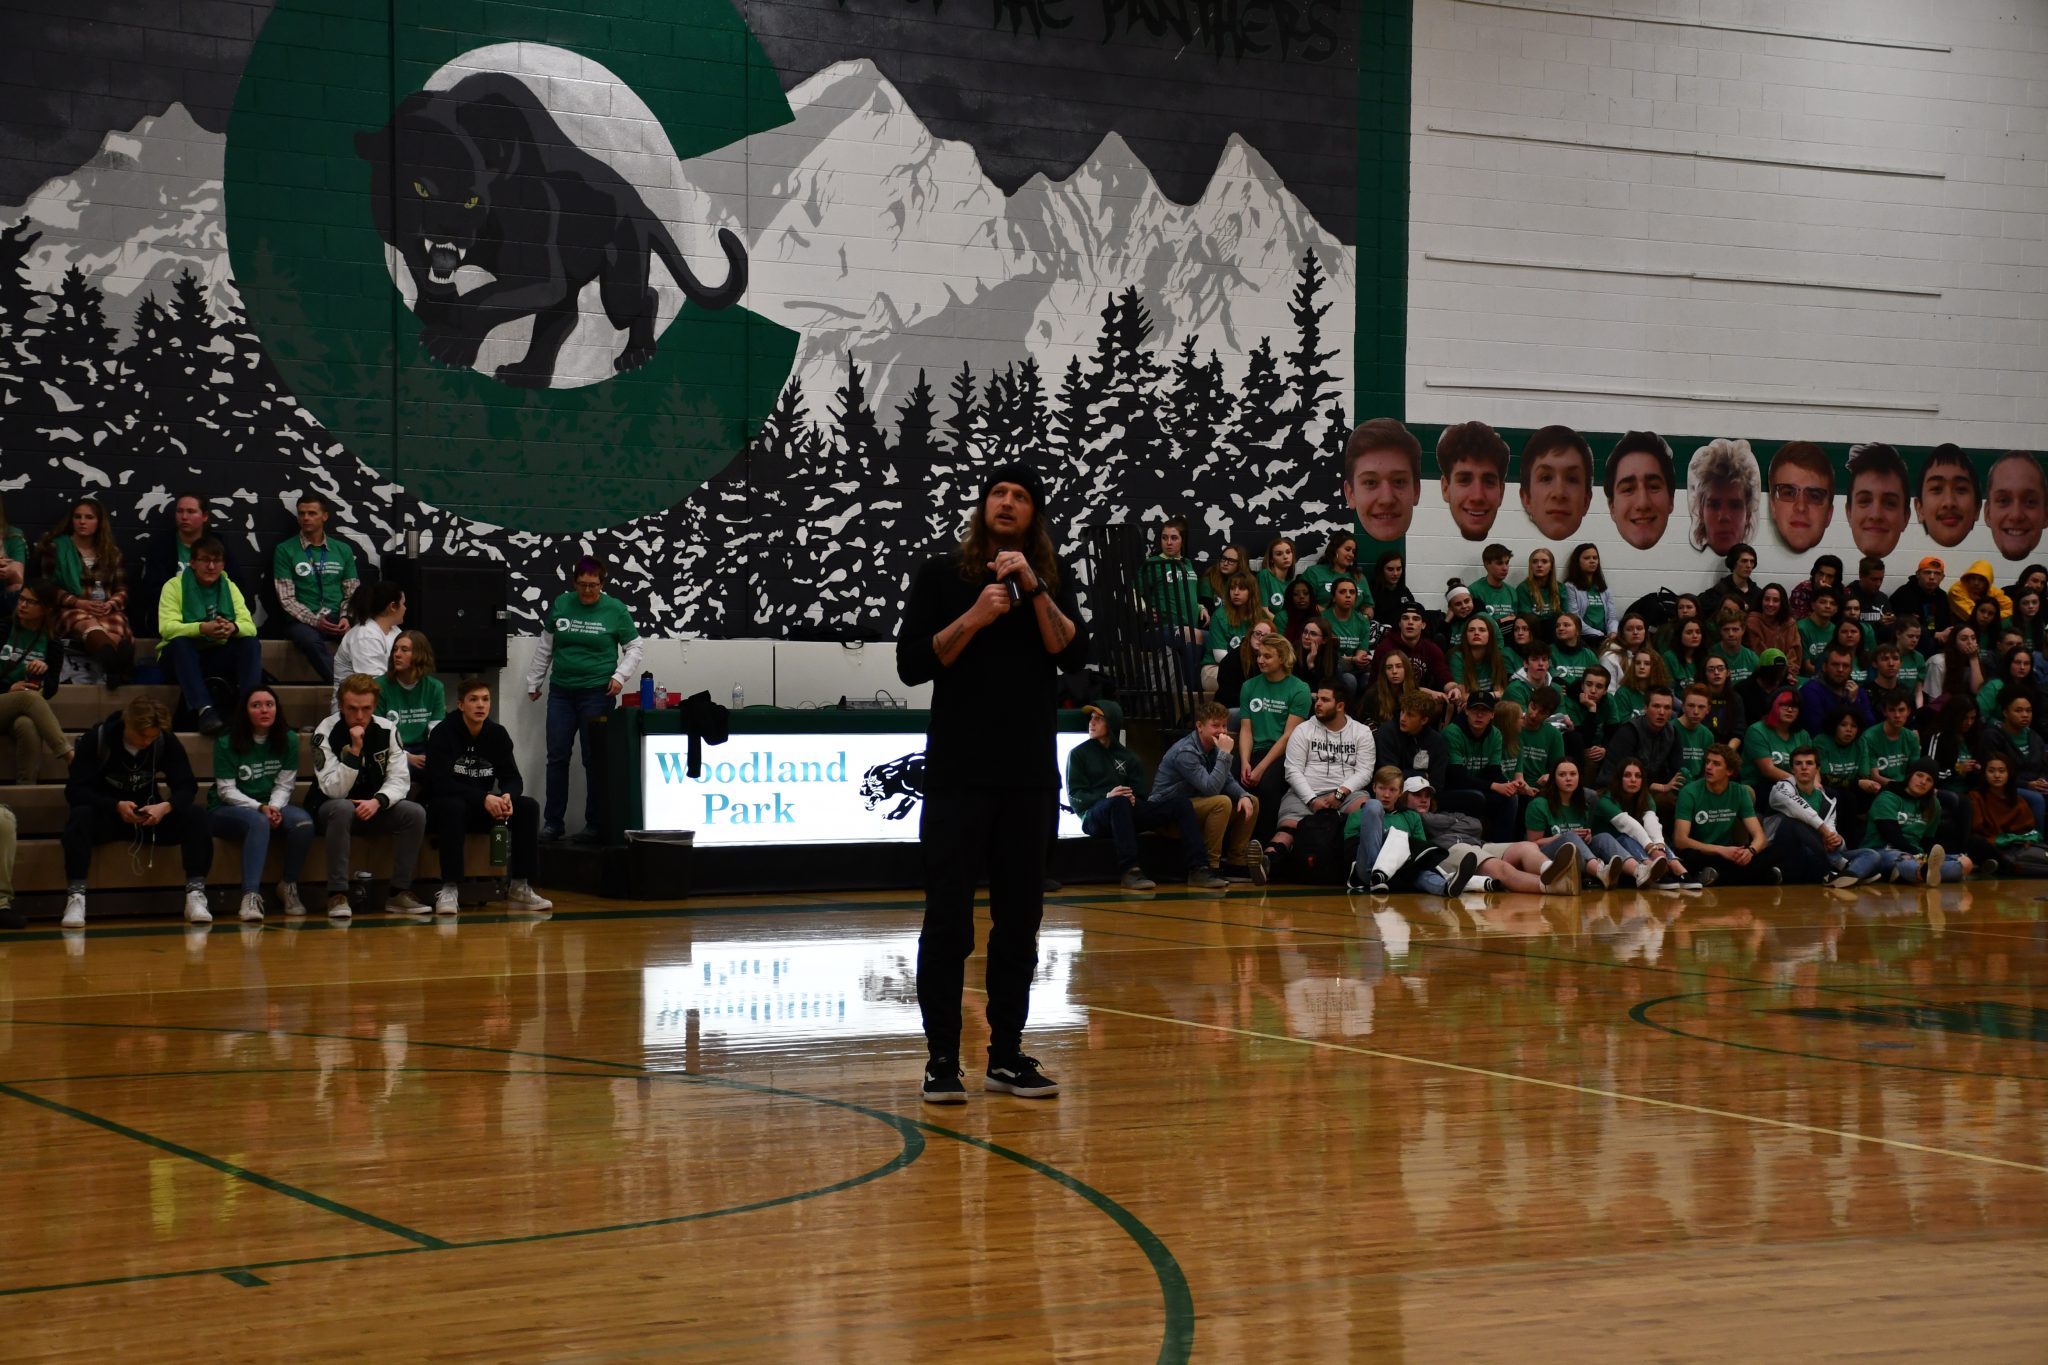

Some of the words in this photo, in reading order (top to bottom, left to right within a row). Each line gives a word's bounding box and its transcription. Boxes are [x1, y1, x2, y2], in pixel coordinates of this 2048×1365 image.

[1311, 741, 1356, 754] PANTHERS
[655, 751, 848, 784] Woodland
[702, 793, 796, 825] Park
